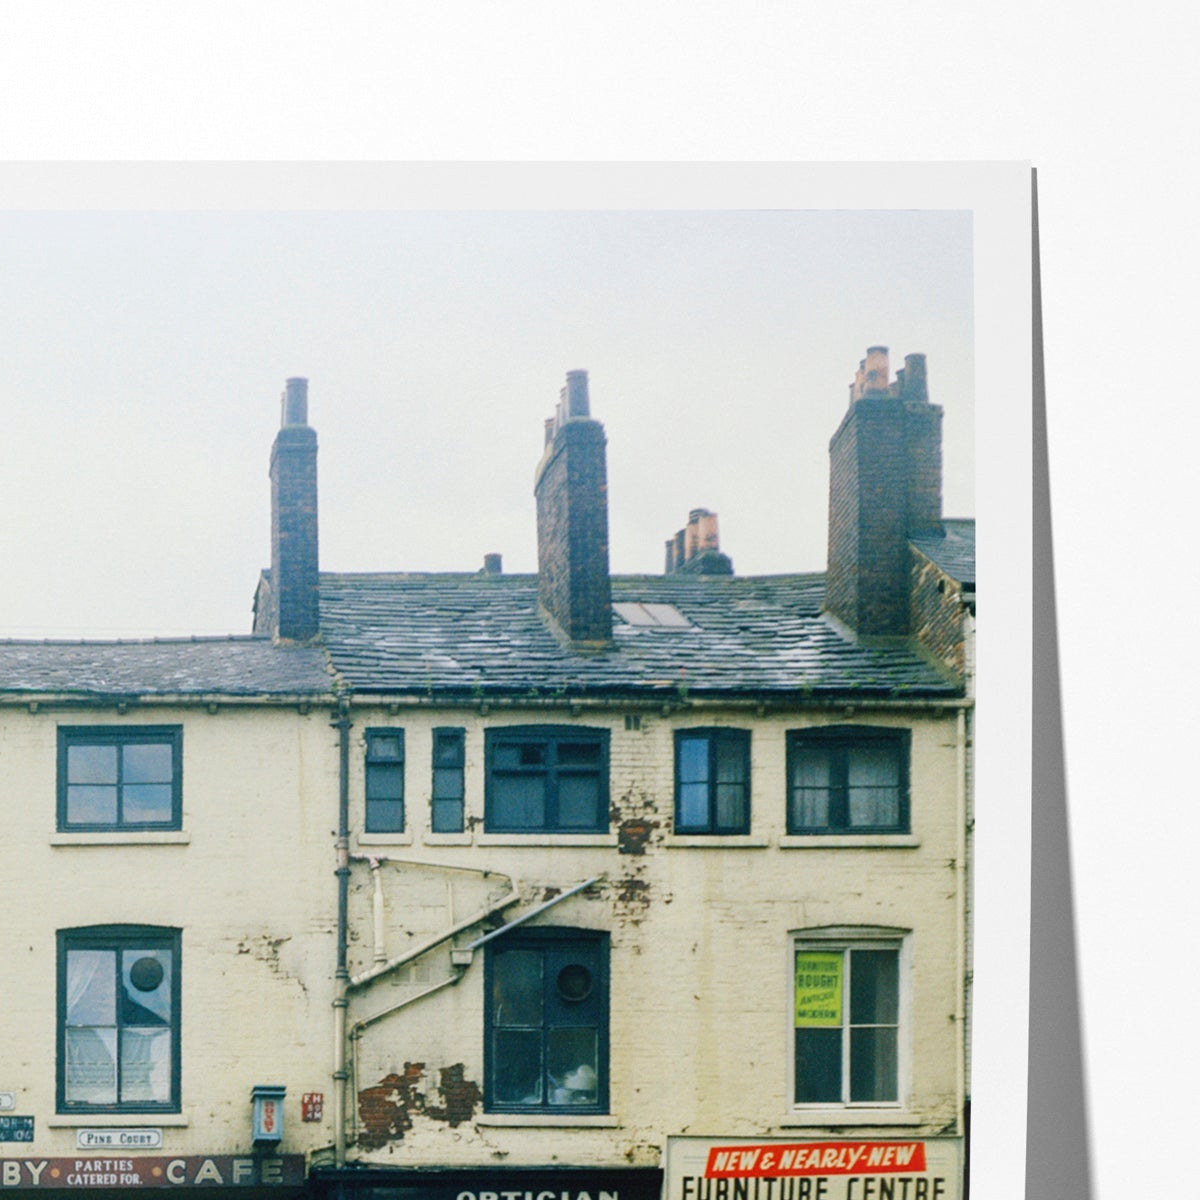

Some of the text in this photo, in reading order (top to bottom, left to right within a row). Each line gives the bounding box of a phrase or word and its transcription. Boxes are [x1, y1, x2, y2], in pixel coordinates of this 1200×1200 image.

[75, 1160, 133, 1171] PARTIES
[712, 1143, 915, 1172] NEW & NEARLY-NEW
[67, 1173, 143, 1185] CATERED FOR.
[166, 1159, 284, 1184] CAFE
